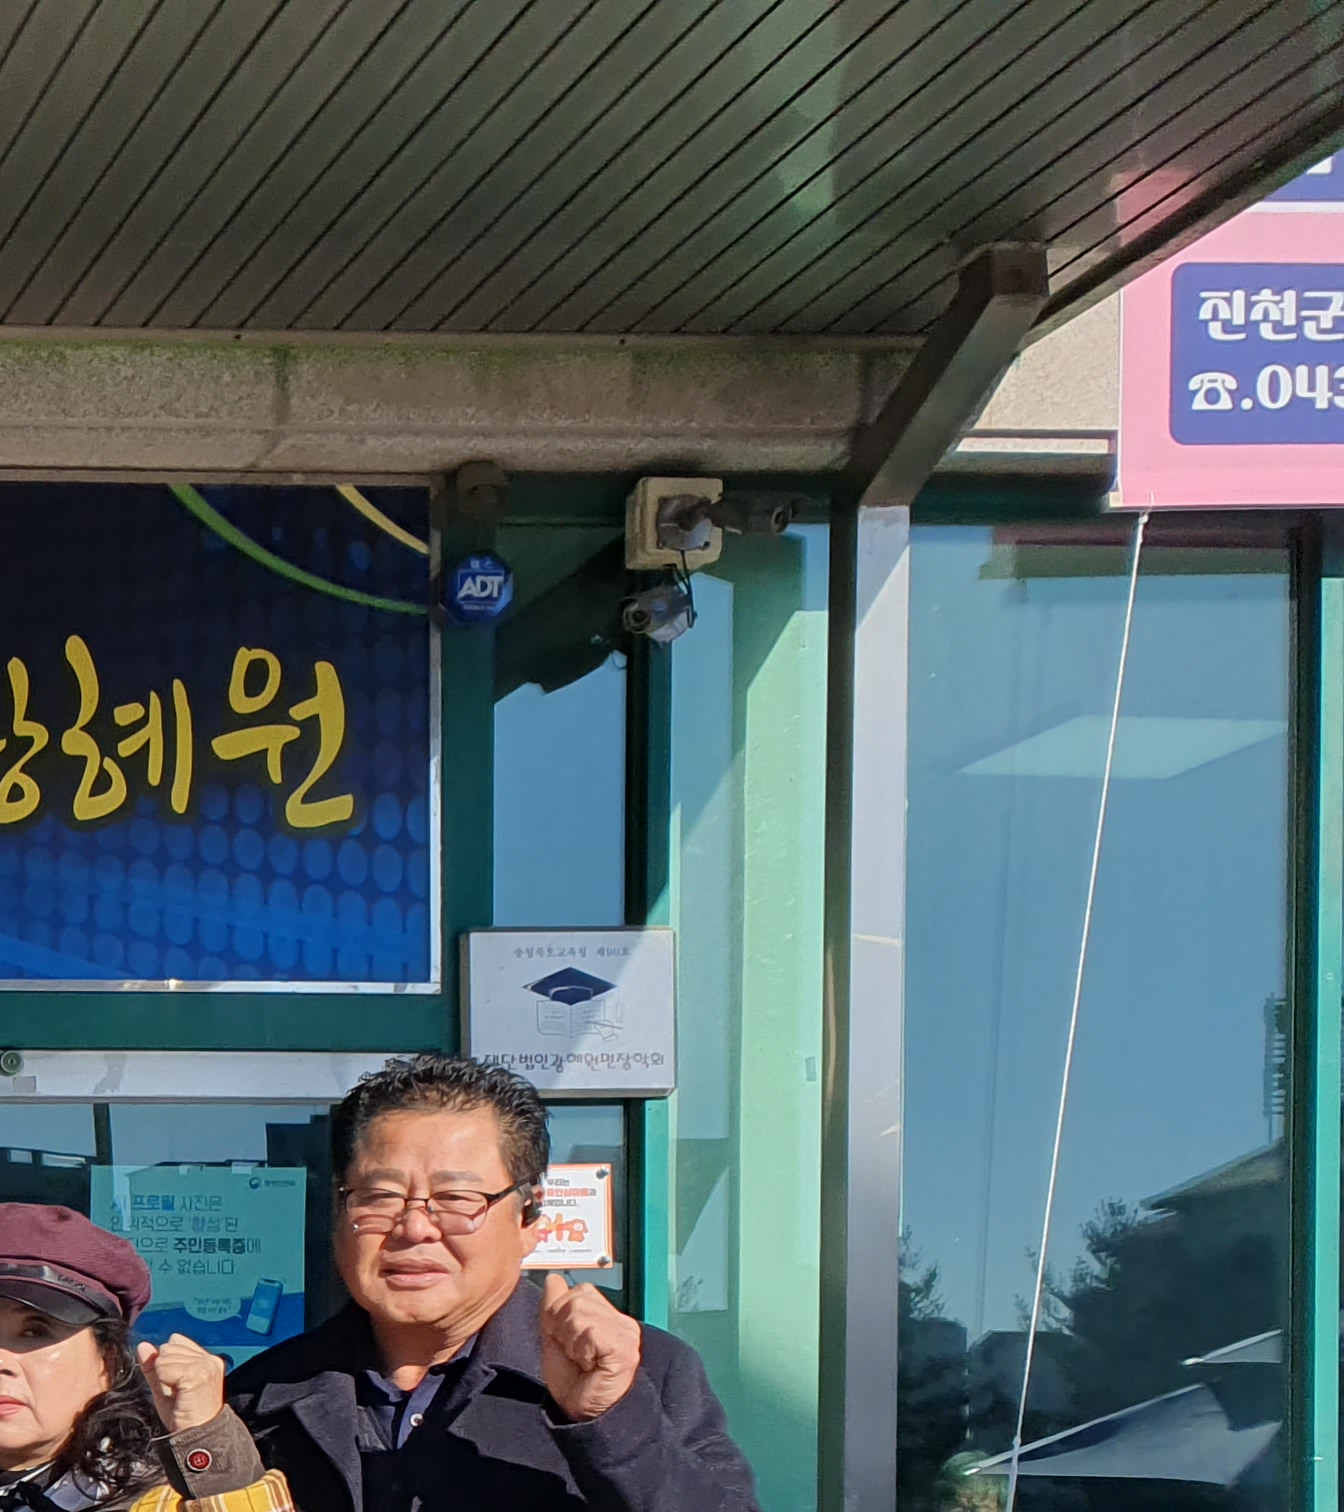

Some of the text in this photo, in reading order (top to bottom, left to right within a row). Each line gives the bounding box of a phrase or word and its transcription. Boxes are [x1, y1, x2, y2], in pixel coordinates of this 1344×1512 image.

[1198, 287, 1344, 341] 진천군
[457, 575, 504, 600] ADT
[132, 1194, 175, 1211] 프로필
[180, 1194, 224, 1212] 사진은
[174, 1237, 262, 1255] 주민등록증에
[159, 1259, 172, 1275] 수
